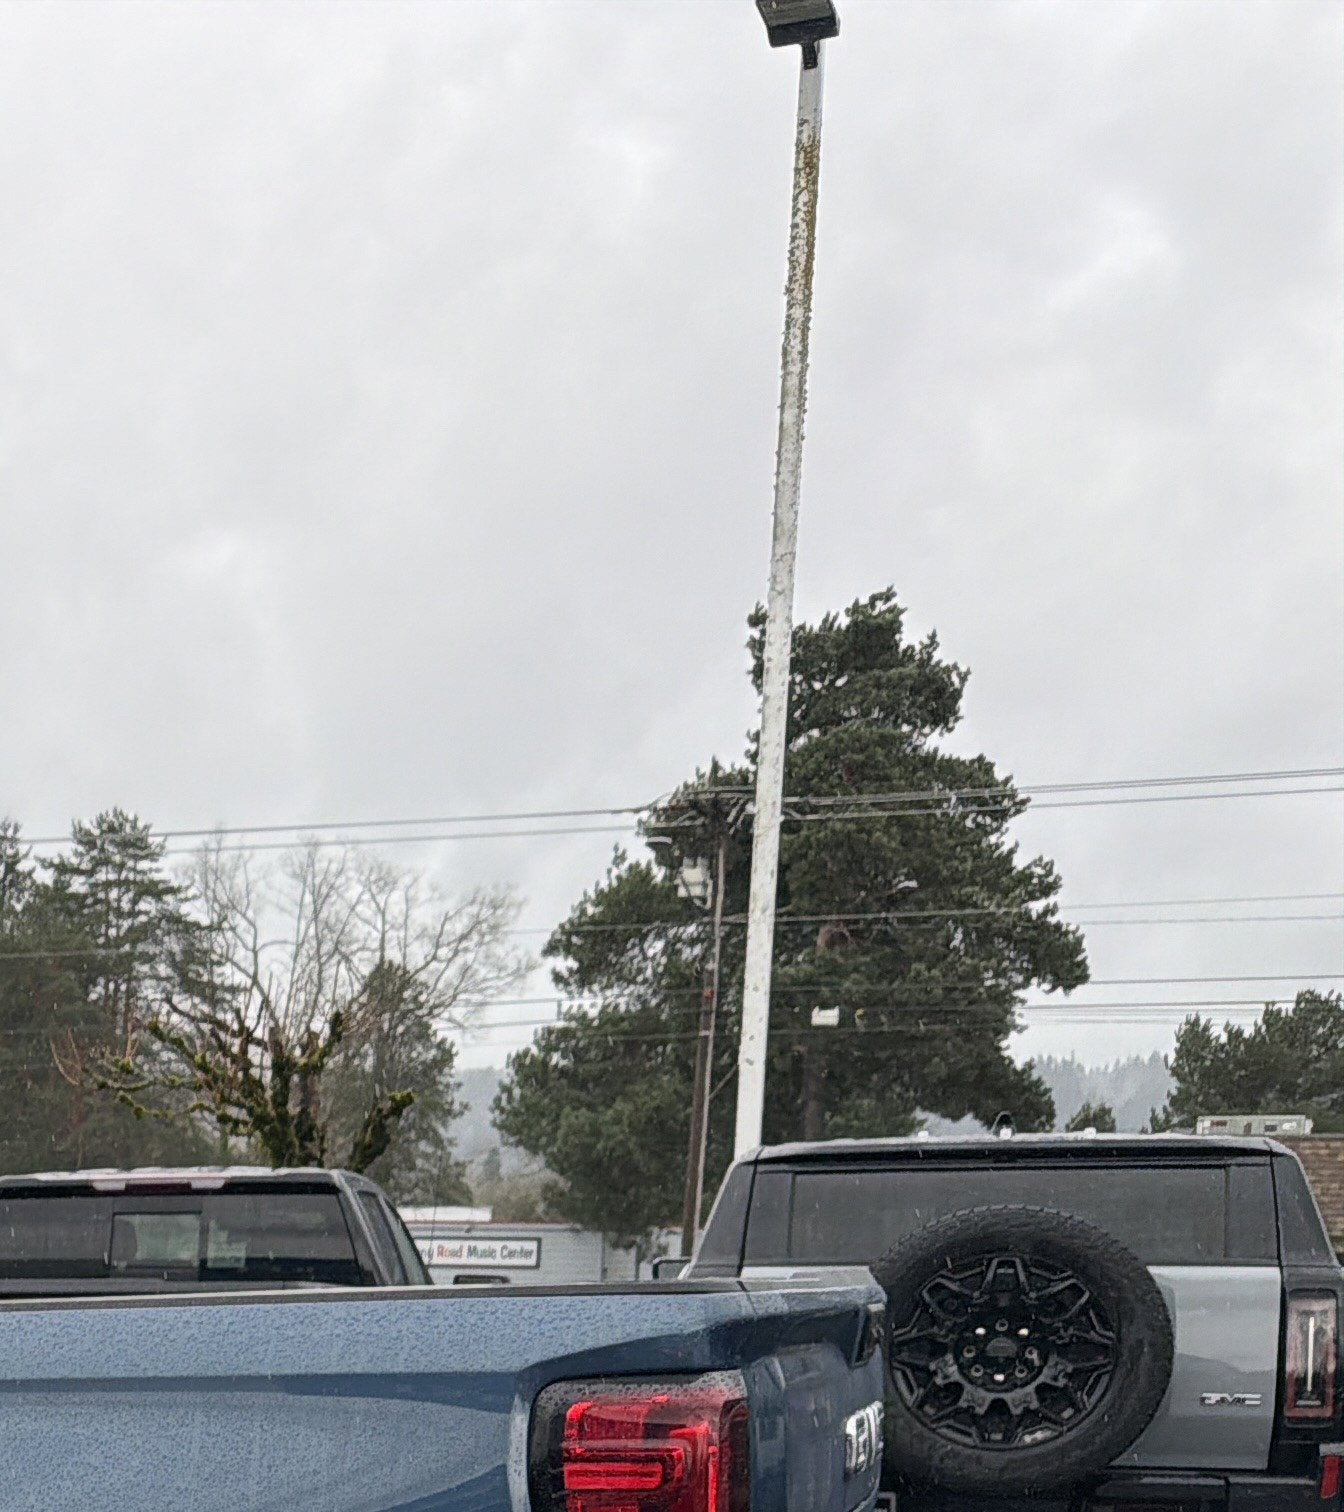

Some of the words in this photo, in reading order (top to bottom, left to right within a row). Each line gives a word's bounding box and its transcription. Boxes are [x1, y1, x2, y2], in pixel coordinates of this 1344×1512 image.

[436, 1244, 463, 1259] Road
[467, 1244, 497, 1260] Music
[500, 1244, 534, 1260] Center
[1200, 1392, 1262, 1406] GMC
